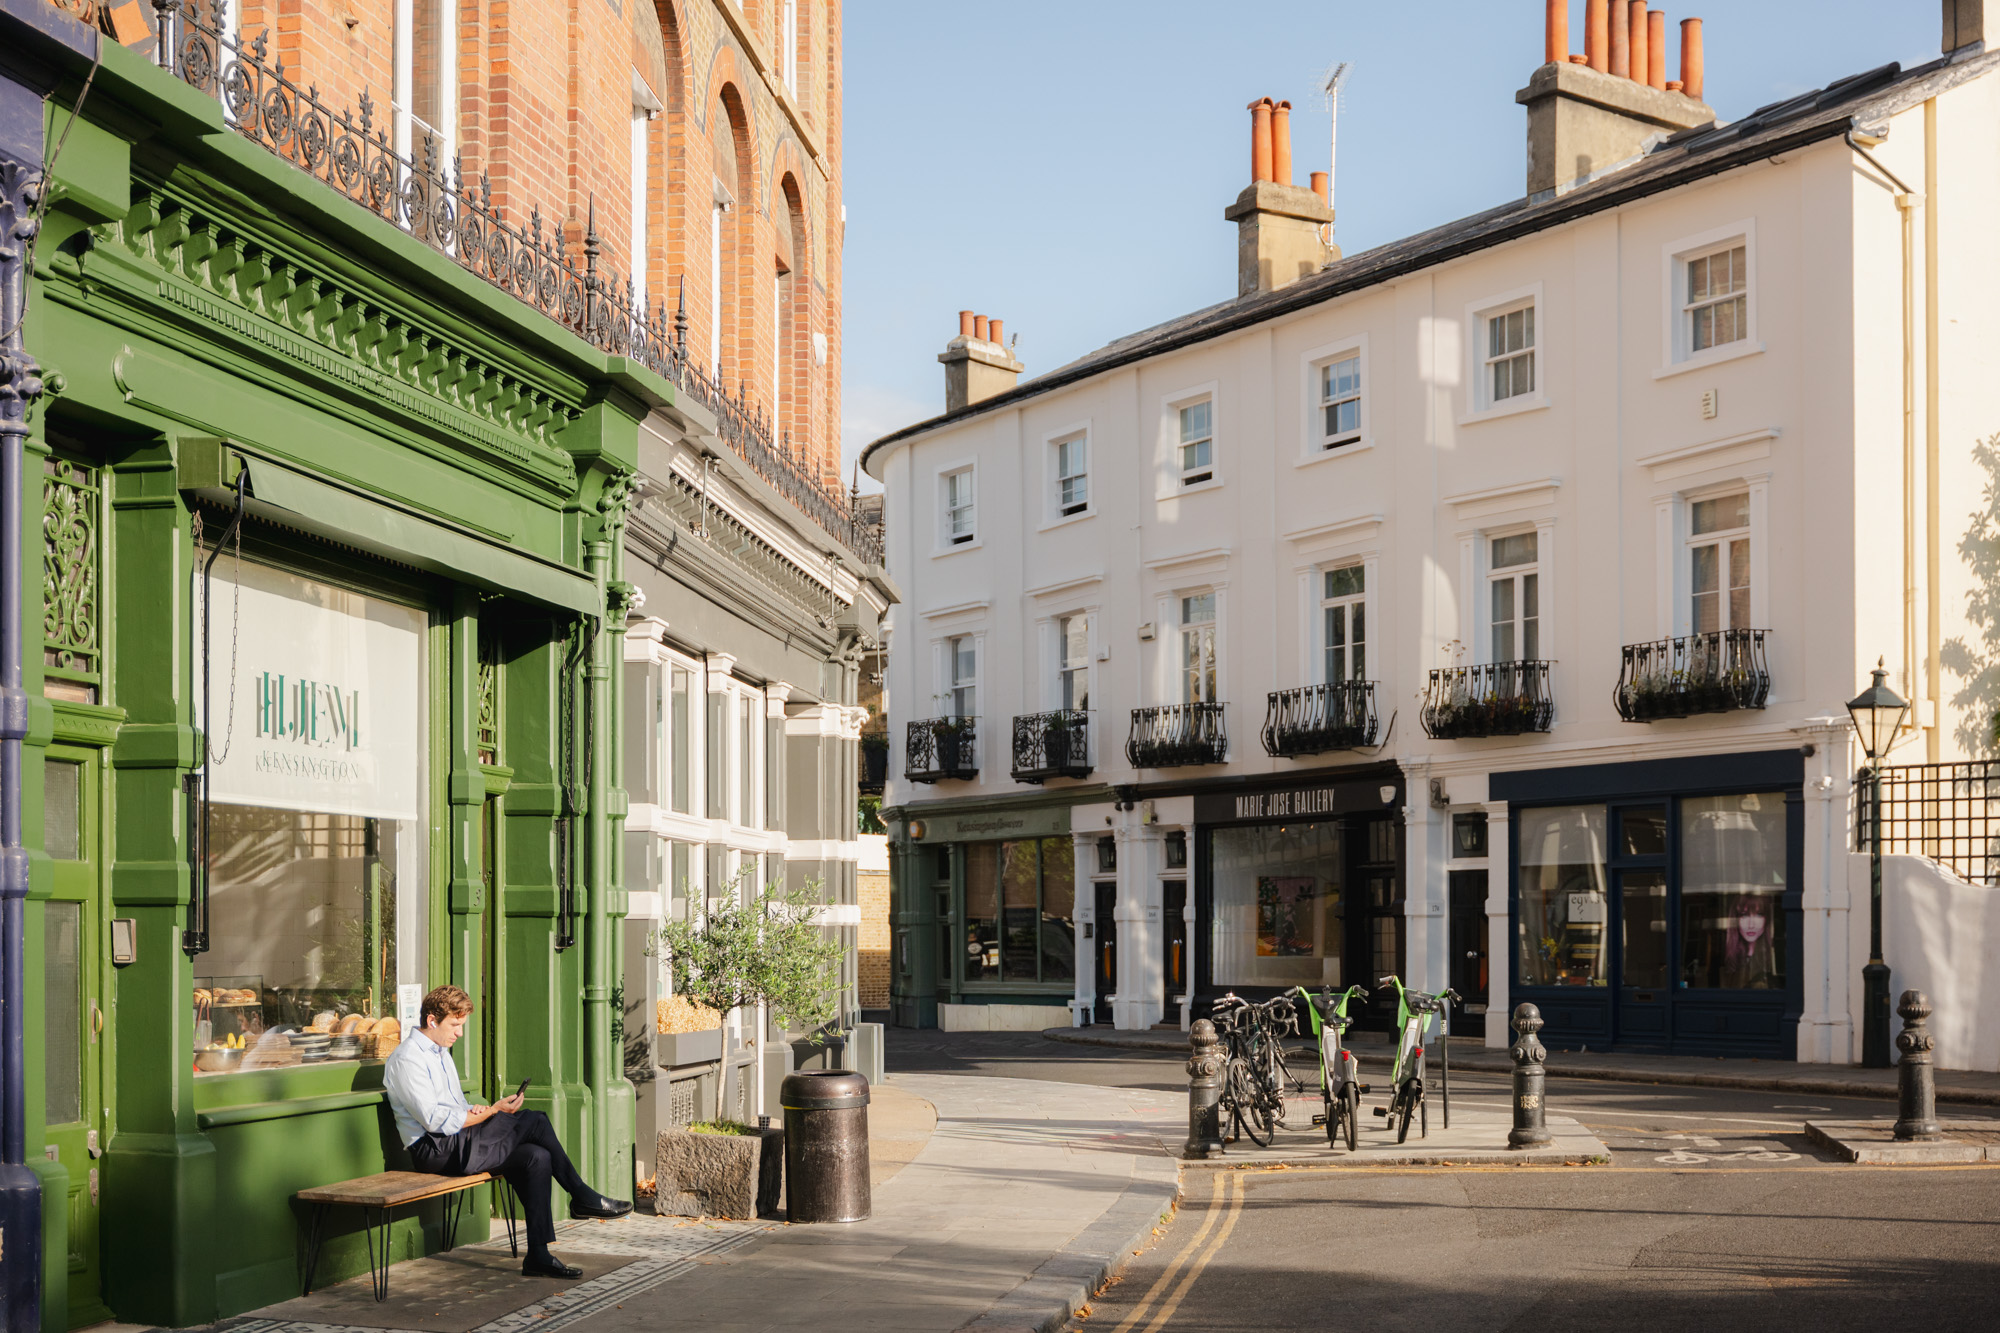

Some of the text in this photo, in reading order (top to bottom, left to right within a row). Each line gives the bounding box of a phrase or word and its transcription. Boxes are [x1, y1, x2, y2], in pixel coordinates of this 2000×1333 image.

[263, 671, 359, 748] HJEM
[262, 750, 359, 779] KENSINGTON
[1235, 788, 1335, 818] MARIE JOSE GALLERY
